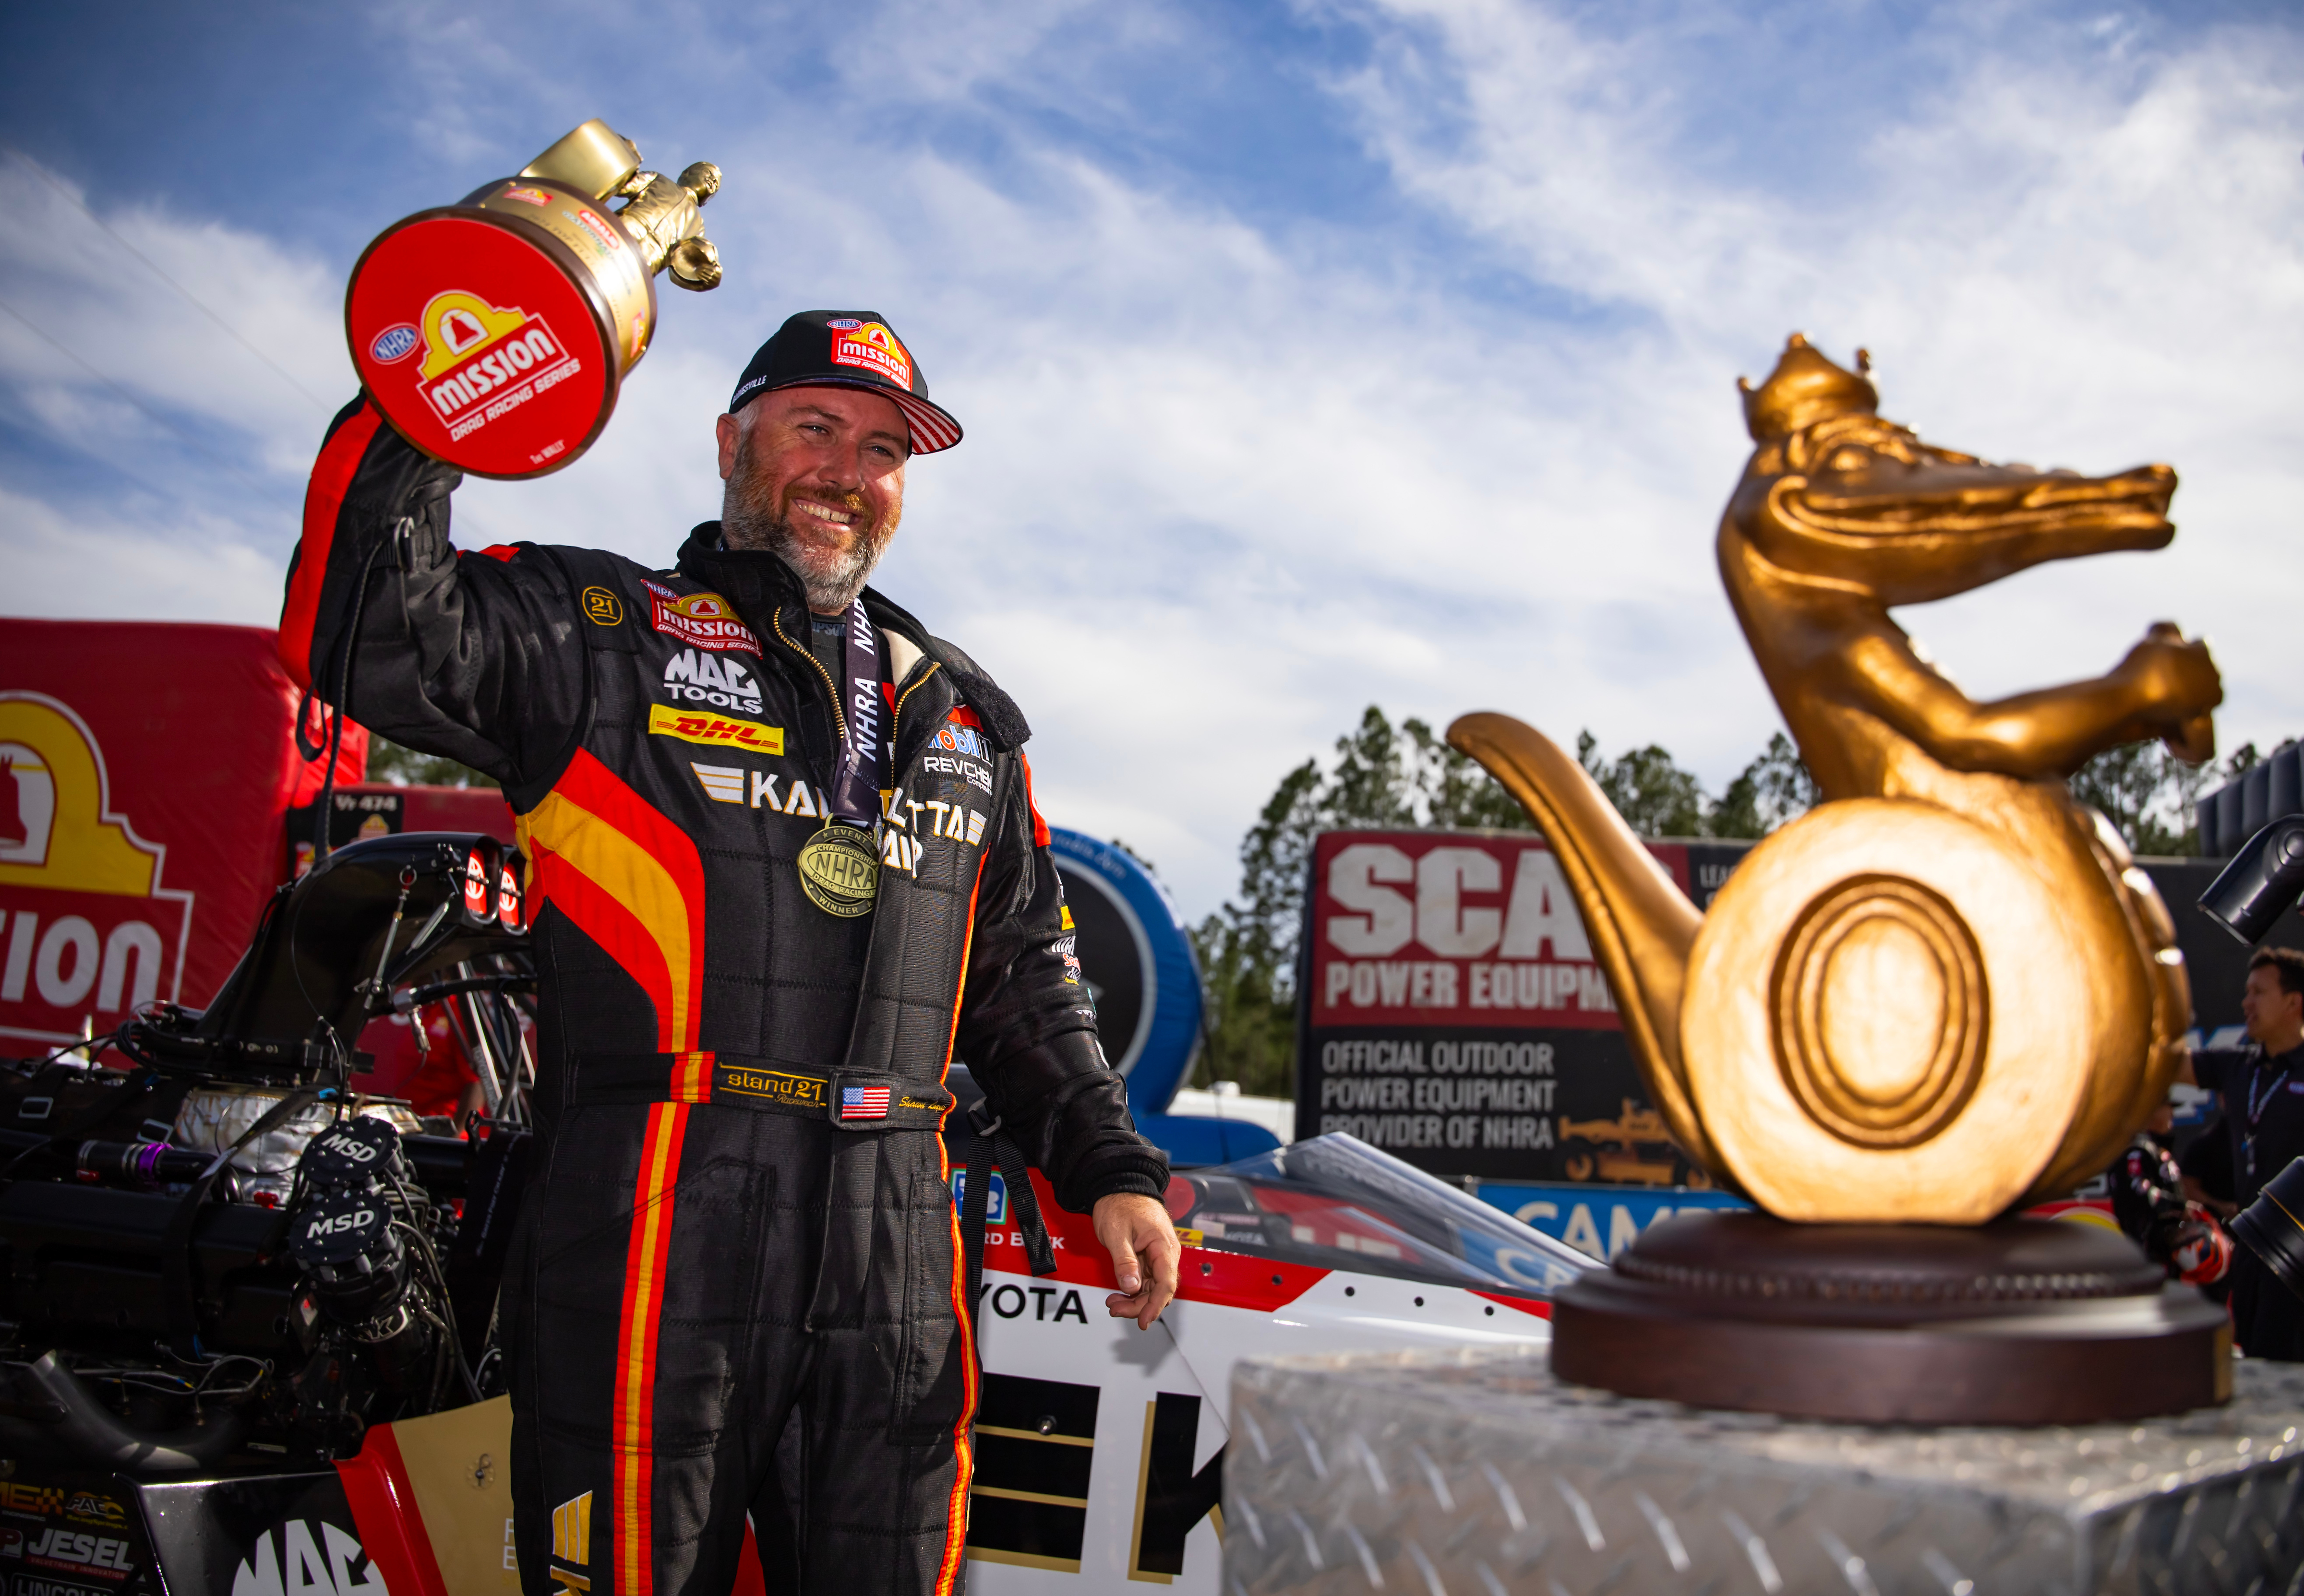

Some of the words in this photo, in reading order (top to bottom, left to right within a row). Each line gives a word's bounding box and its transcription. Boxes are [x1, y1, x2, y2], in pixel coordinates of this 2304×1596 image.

[378, 327, 416, 359] NHRA
[836, 357, 861, 366] DRAG
[861, 362, 891, 376] RACING
[450, 414, 485, 442] DRAG
[486, 385, 534, 423] RACING
[535, 358, 581, 394] SERIES
[647, 583, 672, 598] NHRA
[590, 597, 614, 616] 21
[657, 624, 684, 639] DRAG
[686, 636, 725, 648] RACING
[854, 598, 875, 655] NHR
[664, 648, 761, 698] MAC
[664, 683, 763, 715] TOOLS
[672, 716, 762, 746] DHL
[854, 677, 877, 762] NHRA
[358, 795, 397, 812] 474
[833, 829, 868, 844] EVENT
[817, 845, 876, 866] CHAMPIONSHIP
[812, 872, 835, 890] DRAG
[839, 886, 871, 897] RACING
[815, 853, 875, 888] NHRA
[818, 895, 859, 914] WINNER
[1326, 843, 1595, 959] SCA
[1325, 962, 1458, 1009] POWER
[1469, 963, 1617, 1012] EQUIPM
[1322, 1040, 1428, 1073] OFFICIAL
[1431, 1041, 1554, 1076] OUTDOOR
[774, 1094, 820, 1108] Racewear
[899, 1096, 926, 1109] Shawn
[1321, 1079, 1410, 1109] POWER
[1413, 1078, 1558, 1112] EQUIPMENT
[1321, 1115, 1443, 1147] PROVIDER
[1447, 1117, 1479, 1147] OF
[1483, 1116, 1554, 1149] NHRA
[321, 1133, 377, 1162] MSD
[306, 1210, 375, 1239] MSD
[28, 1528, 134, 1572] JESEL
[16, 1578, 108, 1596] LINCOL
[79, 1566, 126, 1579] INNOVATION
